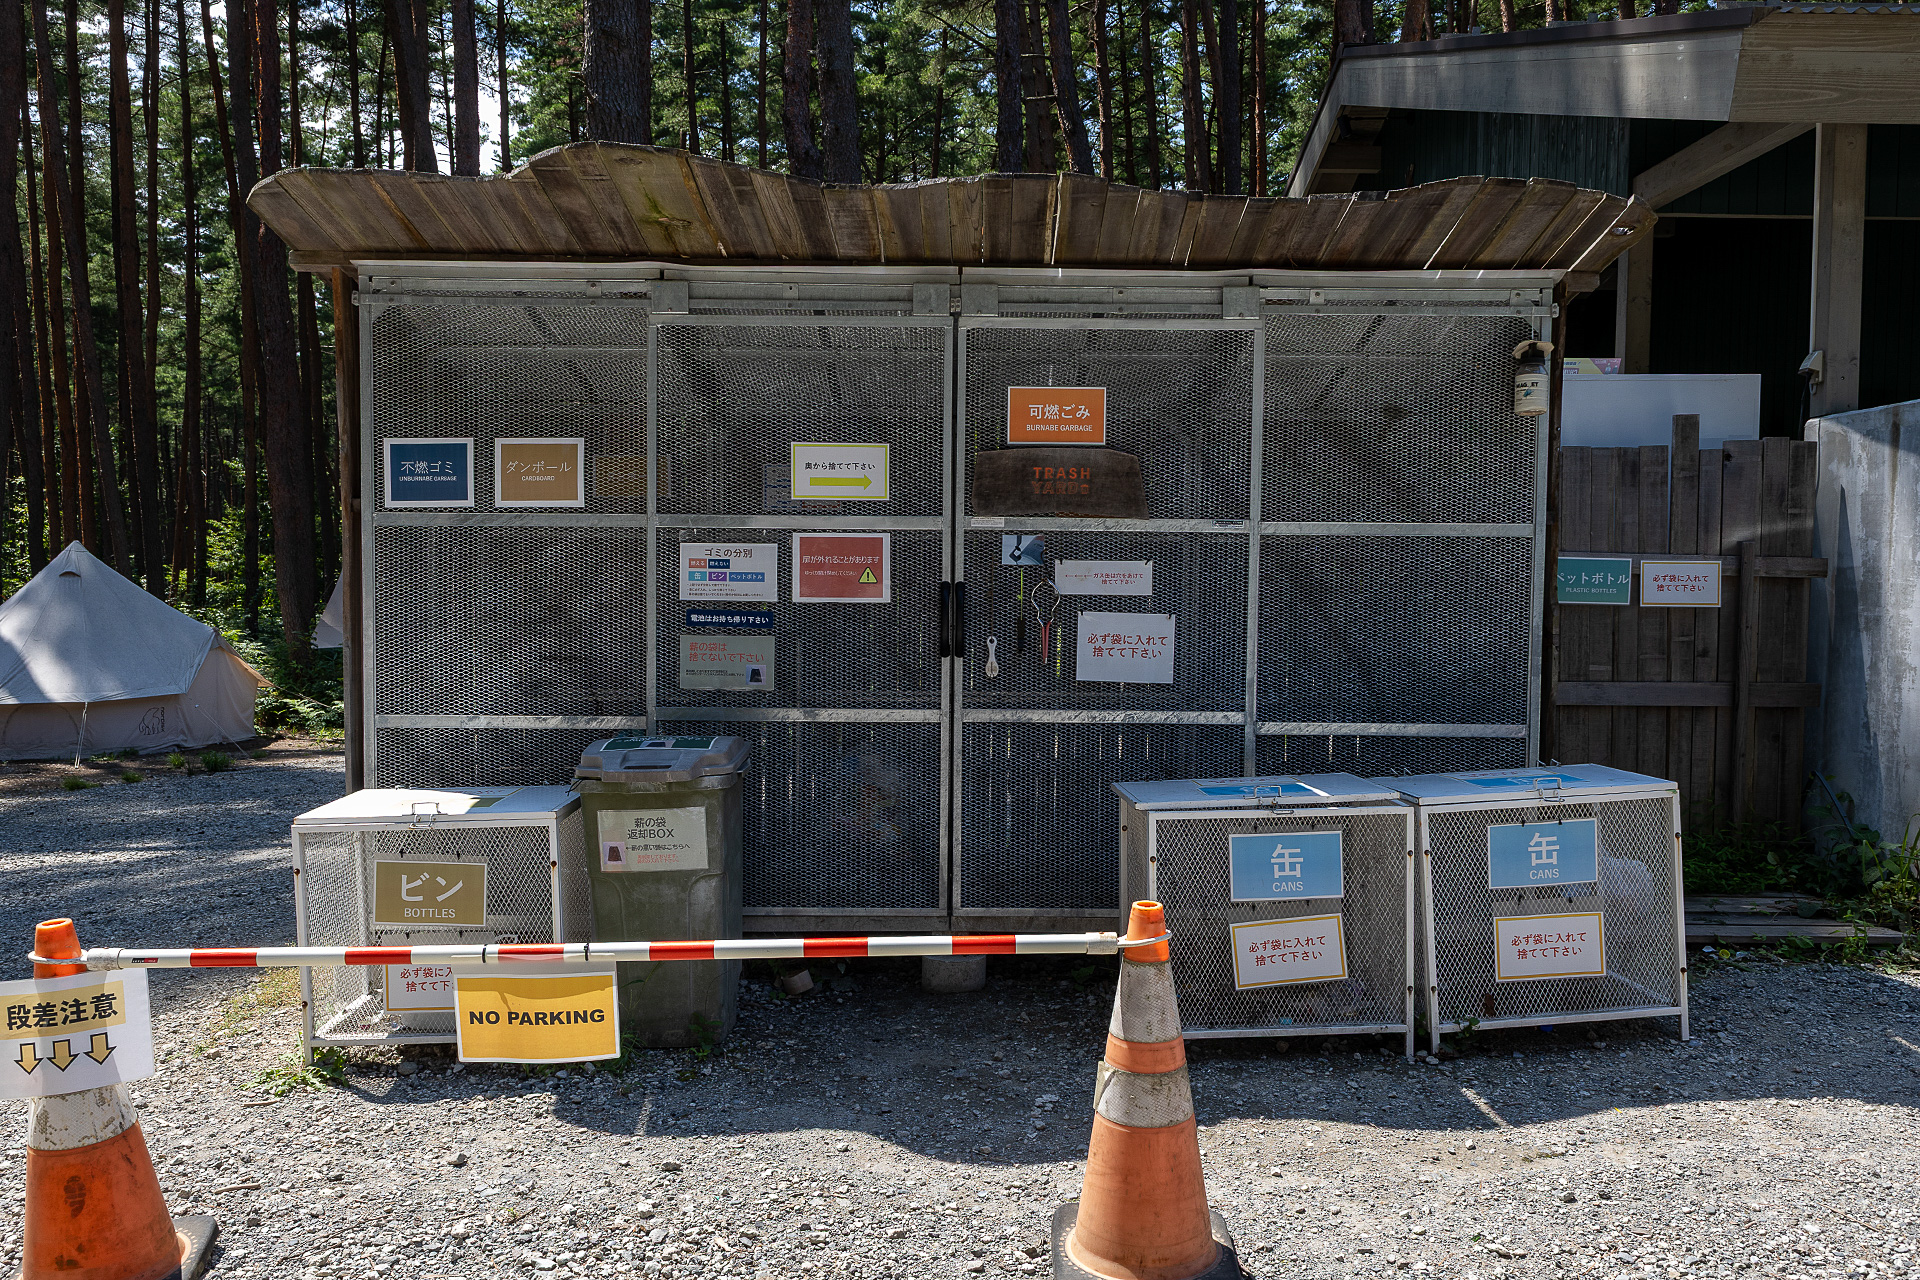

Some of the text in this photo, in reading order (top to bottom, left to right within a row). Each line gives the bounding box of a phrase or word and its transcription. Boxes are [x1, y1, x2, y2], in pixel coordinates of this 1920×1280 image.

[1028, 404, 1091, 420] 可燃ごみ
[1026, 424, 1093, 432] BURNABE GARBAGE
[400, 460, 454, 474] 不燃ゴミ
[805, 462, 876, 471] 奥から捨てて下さい
[1033, 467, 1091, 479] TRASH
[1031, 481, 1077, 494] YARD
[704, 548, 753, 558] ゴミの分別
[802, 555, 880, 564] 扉が外れることがあります
[694, 572, 702, 580] 缶
[1652, 574, 1709, 583] 必ず袋に入れて
[1656, 584, 1705, 592] 捨てて下さい
[690, 614, 769, 624] 電池はお持ち帰り下さい
[1087, 632, 1169, 647] 必ず袋に入れて
[689, 642, 728, 652] 薪の袋は
[1092, 646, 1162, 659] 捨てて下さい
[689, 652, 764, 663] 捨てないで下さい
[634, 817, 667, 829] 薪の袋
[627, 828, 675, 840] 返却BOX
[1527, 832, 1560, 867] 缶
[1270, 843, 1304, 879] 缶
[1529, 868, 1560, 880] CANS
[401, 872, 463, 902] ビン
[1272, 881, 1304, 892] CANS
[404, 907, 456, 919] BOTTLES
[1248, 935, 1327, 953] 必ず袋に入れて
[1511, 932, 1587, 947] 必ず袋に入れて
[1254, 950, 1323, 967] 捨てて下さい
[1517, 946, 1582, 960] 捨てて下さい
[405, 981, 454, 993] 捨てて下
[6, 993, 119, 1031] 段差注意
[469, 1009, 605, 1026] NO PARKING
